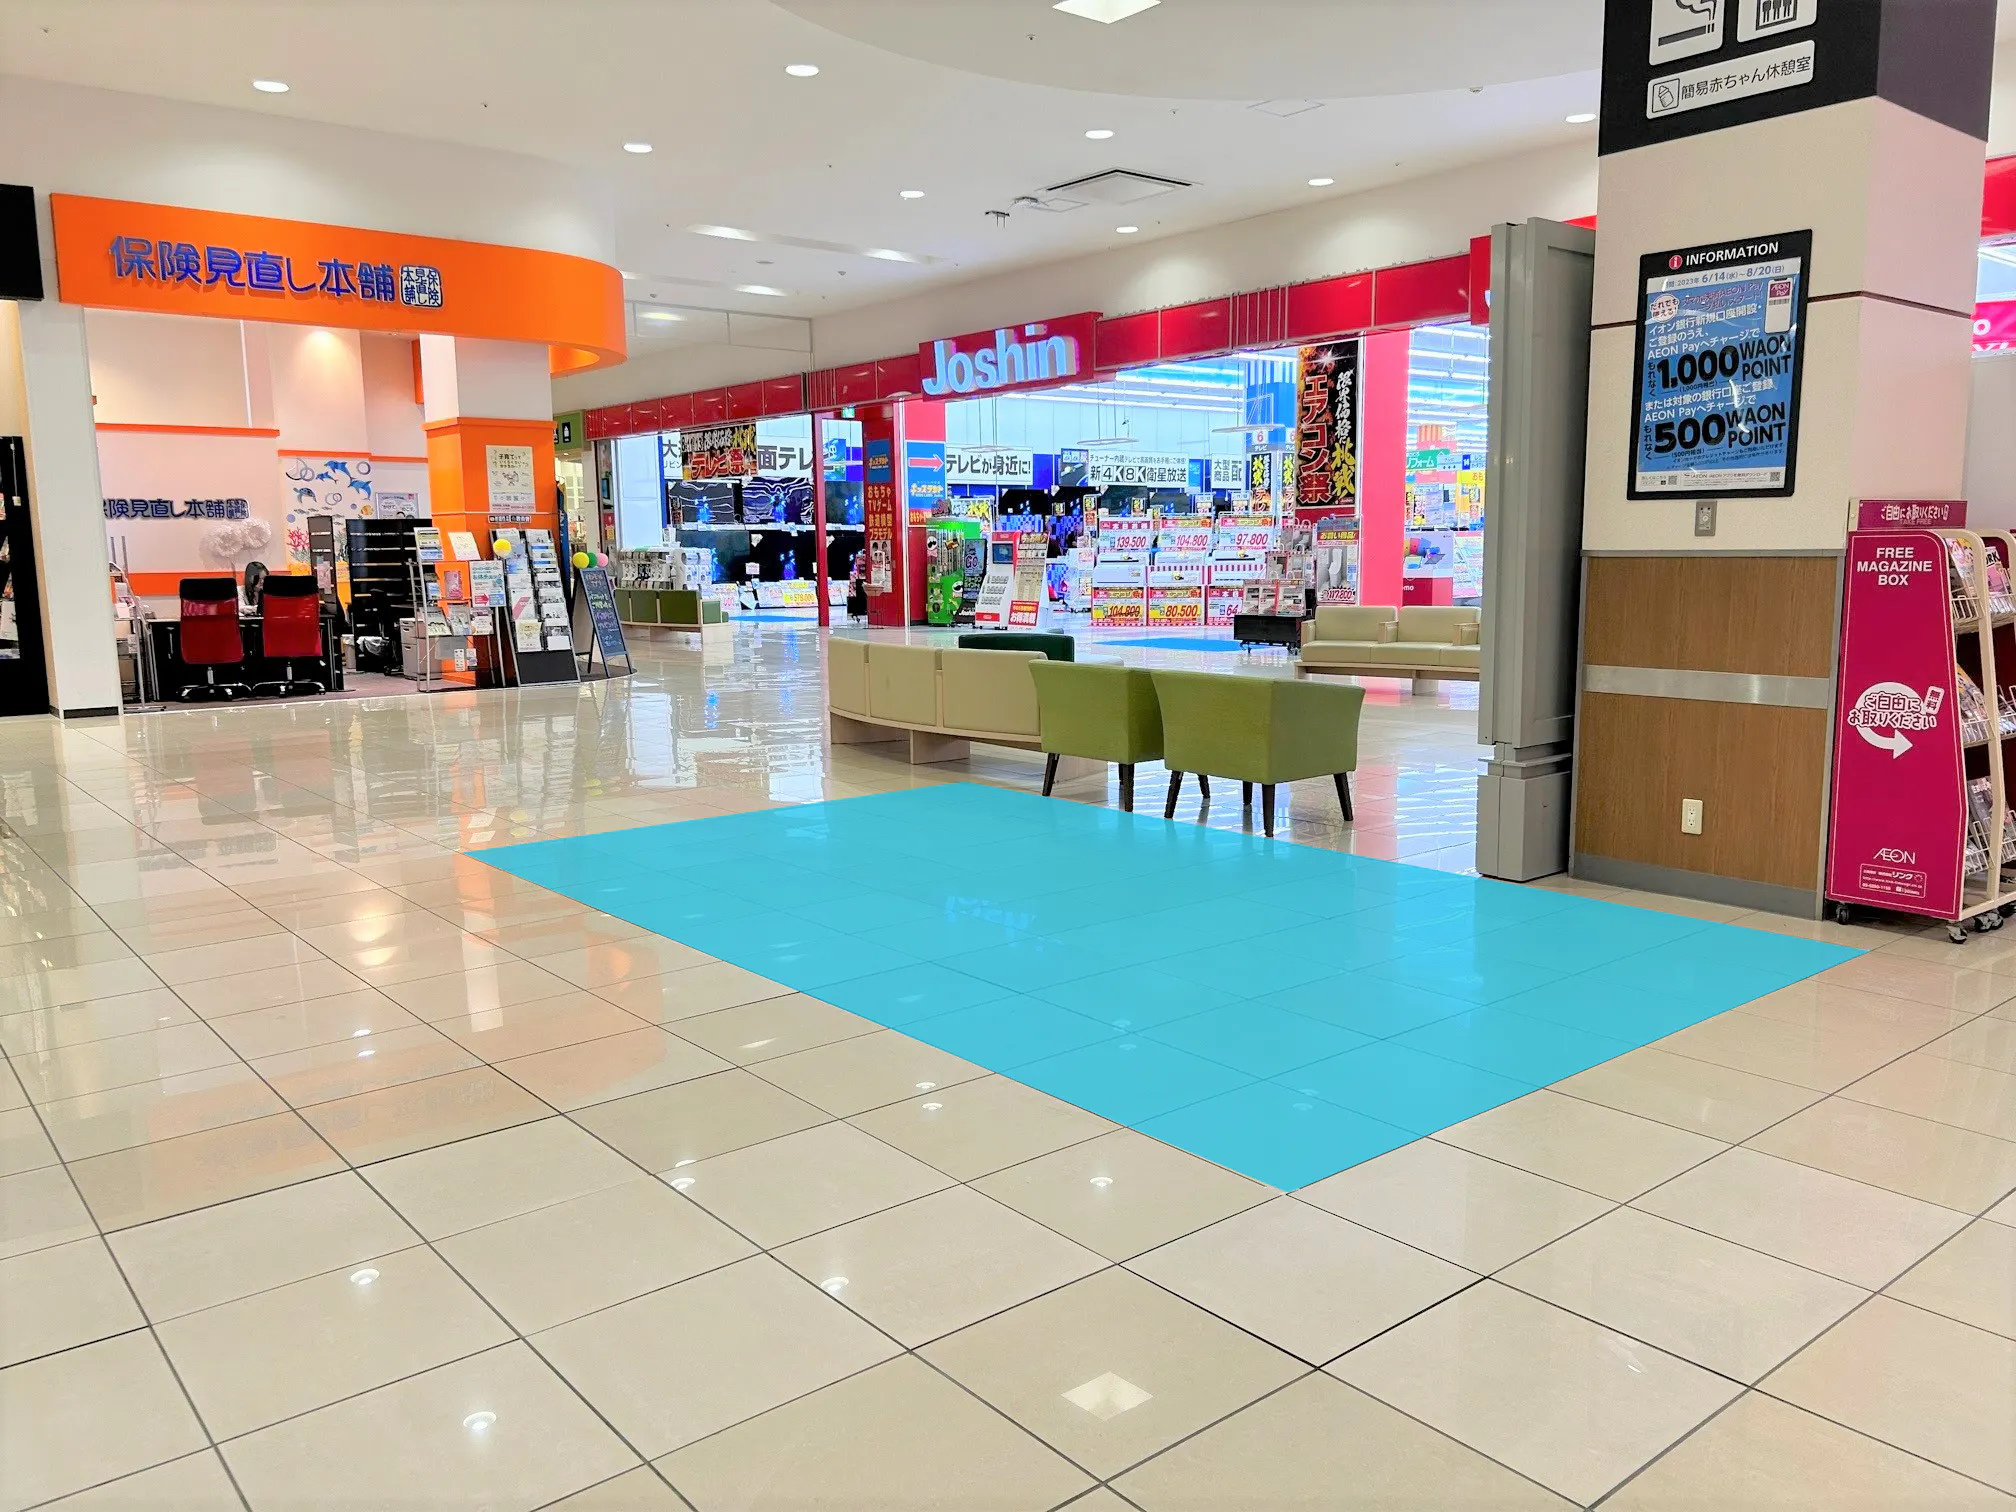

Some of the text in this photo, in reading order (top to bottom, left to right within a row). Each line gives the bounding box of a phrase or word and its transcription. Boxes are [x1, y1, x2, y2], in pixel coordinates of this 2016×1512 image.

[1681, 56, 1811, 100] 簡易赤ちゃん休憩室
[1686, 241, 1779, 266] INFORMATION
[110, 236, 395, 302] 保険見直し本舗
[922, 324, 1067, 396] Joshin
[1740, 335, 1791, 360] WAON
[1648, 361, 1656, 397] もれなく
[1742, 355, 1791, 381] POINT
[1726, 402, 1785, 428] WAON
[1299, 374, 1332, 503] エアコン祭
[1644, 425, 1652, 460] もれなく
[1654, 413, 1727, 453] 500
[1728, 422, 1786, 448] POINT
[946, 454, 1031, 476] テレビが身近に!
[867, 486, 892, 498] おもちゃ
[868, 500, 892, 511] TVゲーム
[869, 527, 893, 540] プラモデル
[1876, 547, 1914, 558] FREE
[1857, 561, 1932, 572] MAGAZINE
[1878, 574, 1908, 586] BOX
[1865, 694, 1919, 711] ご自由に
[1848, 709, 1936, 729] お取りください
